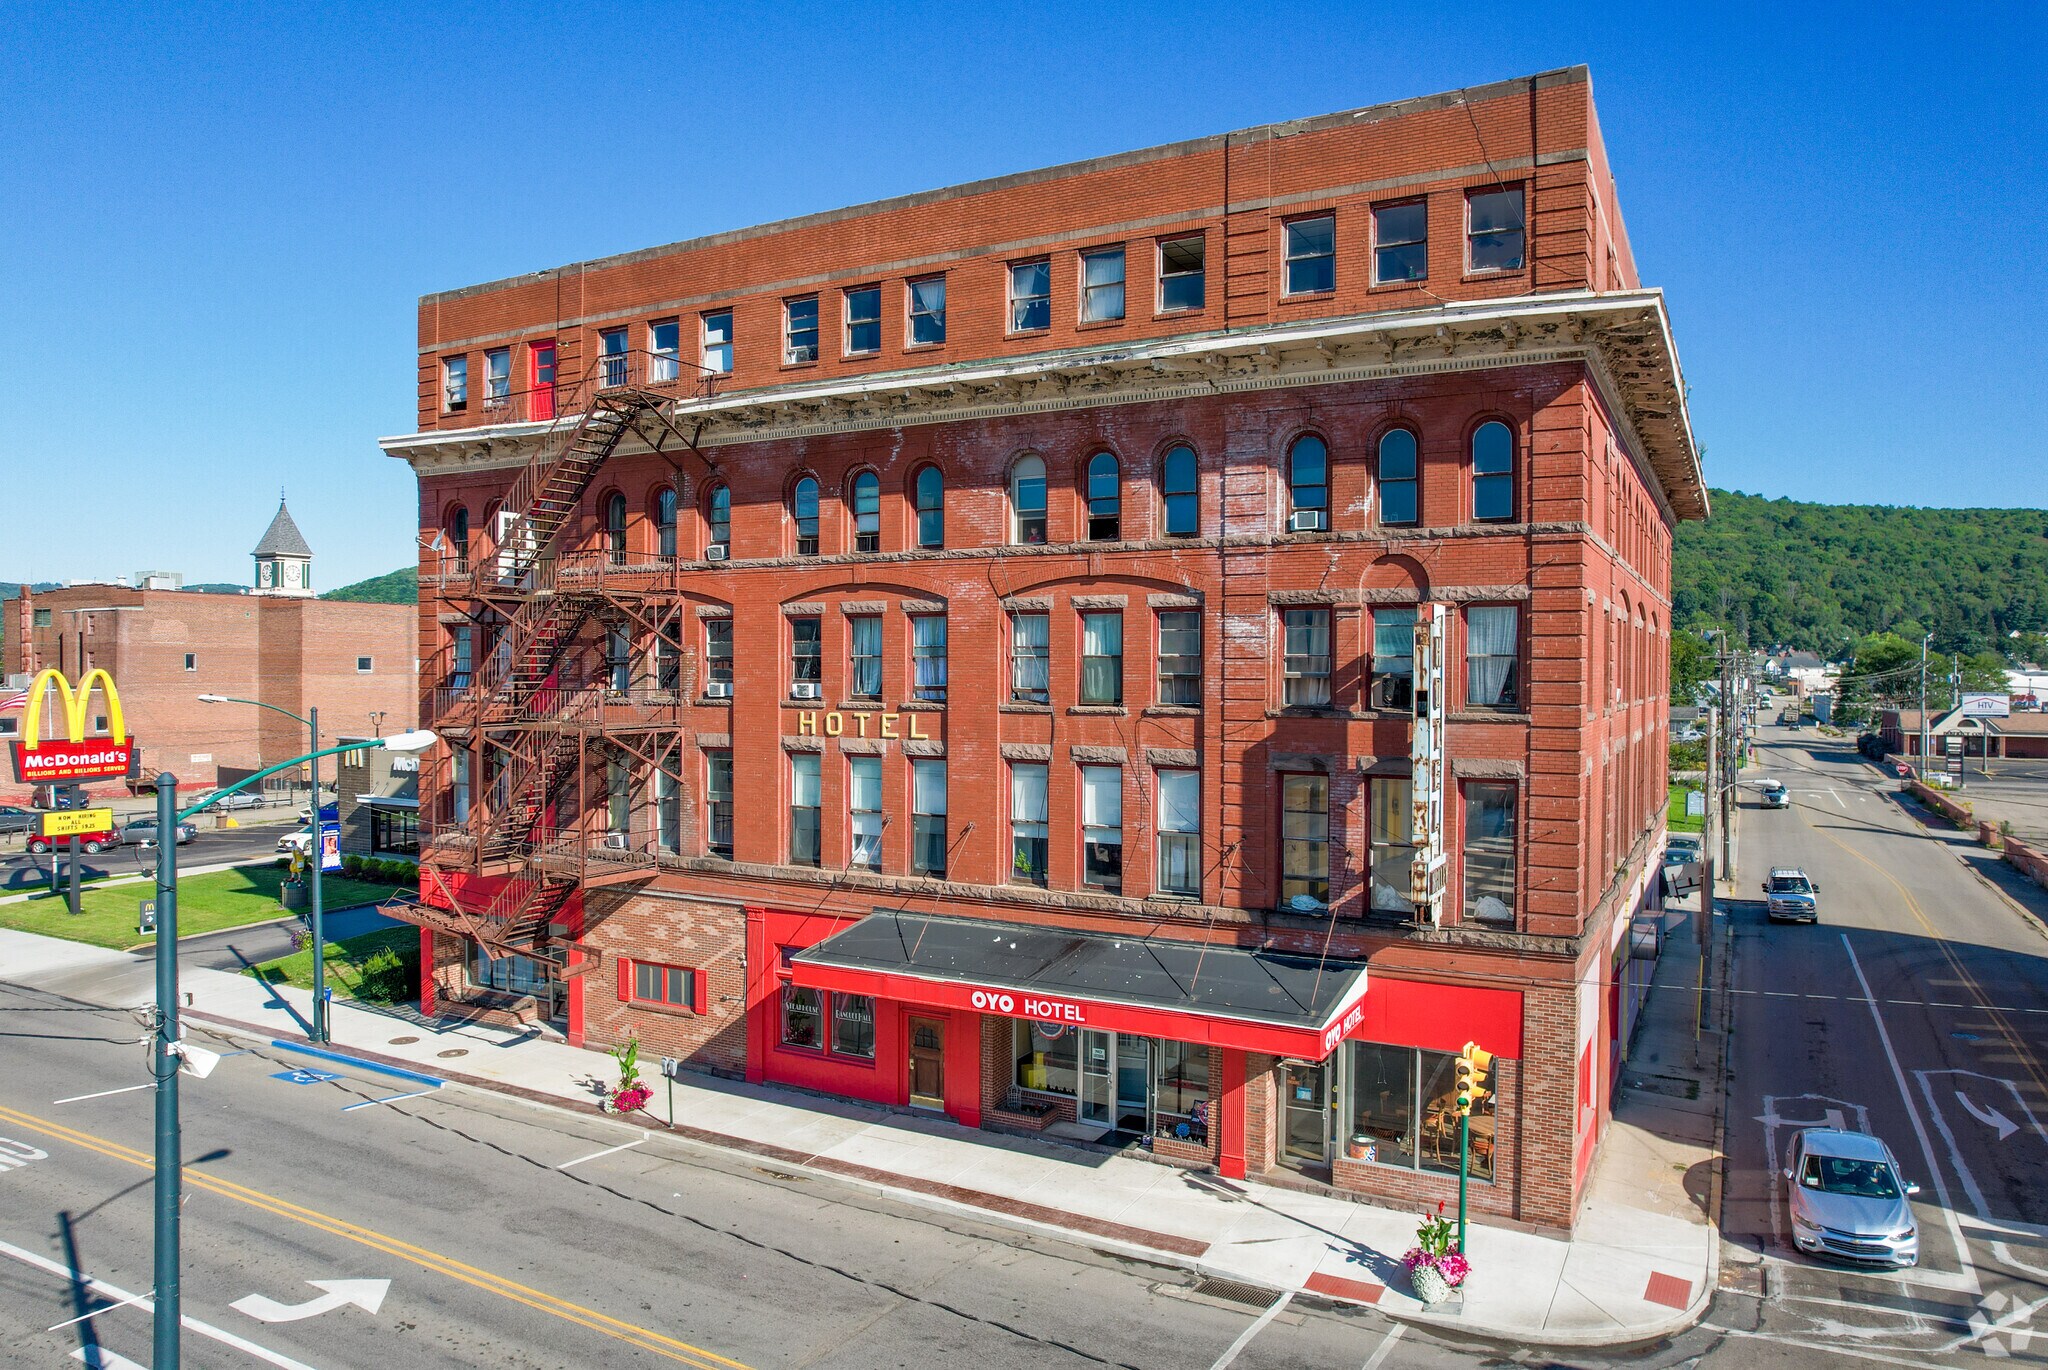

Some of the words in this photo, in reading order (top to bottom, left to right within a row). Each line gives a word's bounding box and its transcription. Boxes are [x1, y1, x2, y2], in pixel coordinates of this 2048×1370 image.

[1977, 701, 1994, 709] HTV
[798, 711, 929, 739] HOTEL
[25, 751, 127, 768] McDonald's
[27, 769, 56, 777] BILLIONS
[74, 766, 102, 774] BILLIONS
[971, 990, 1015, 1013] OYO
[1024, 998, 1086, 1022] HOTEL
[1325, 1022, 1341, 1051] OYO
[1343, 1005, 1362, 1034] HOTEL
